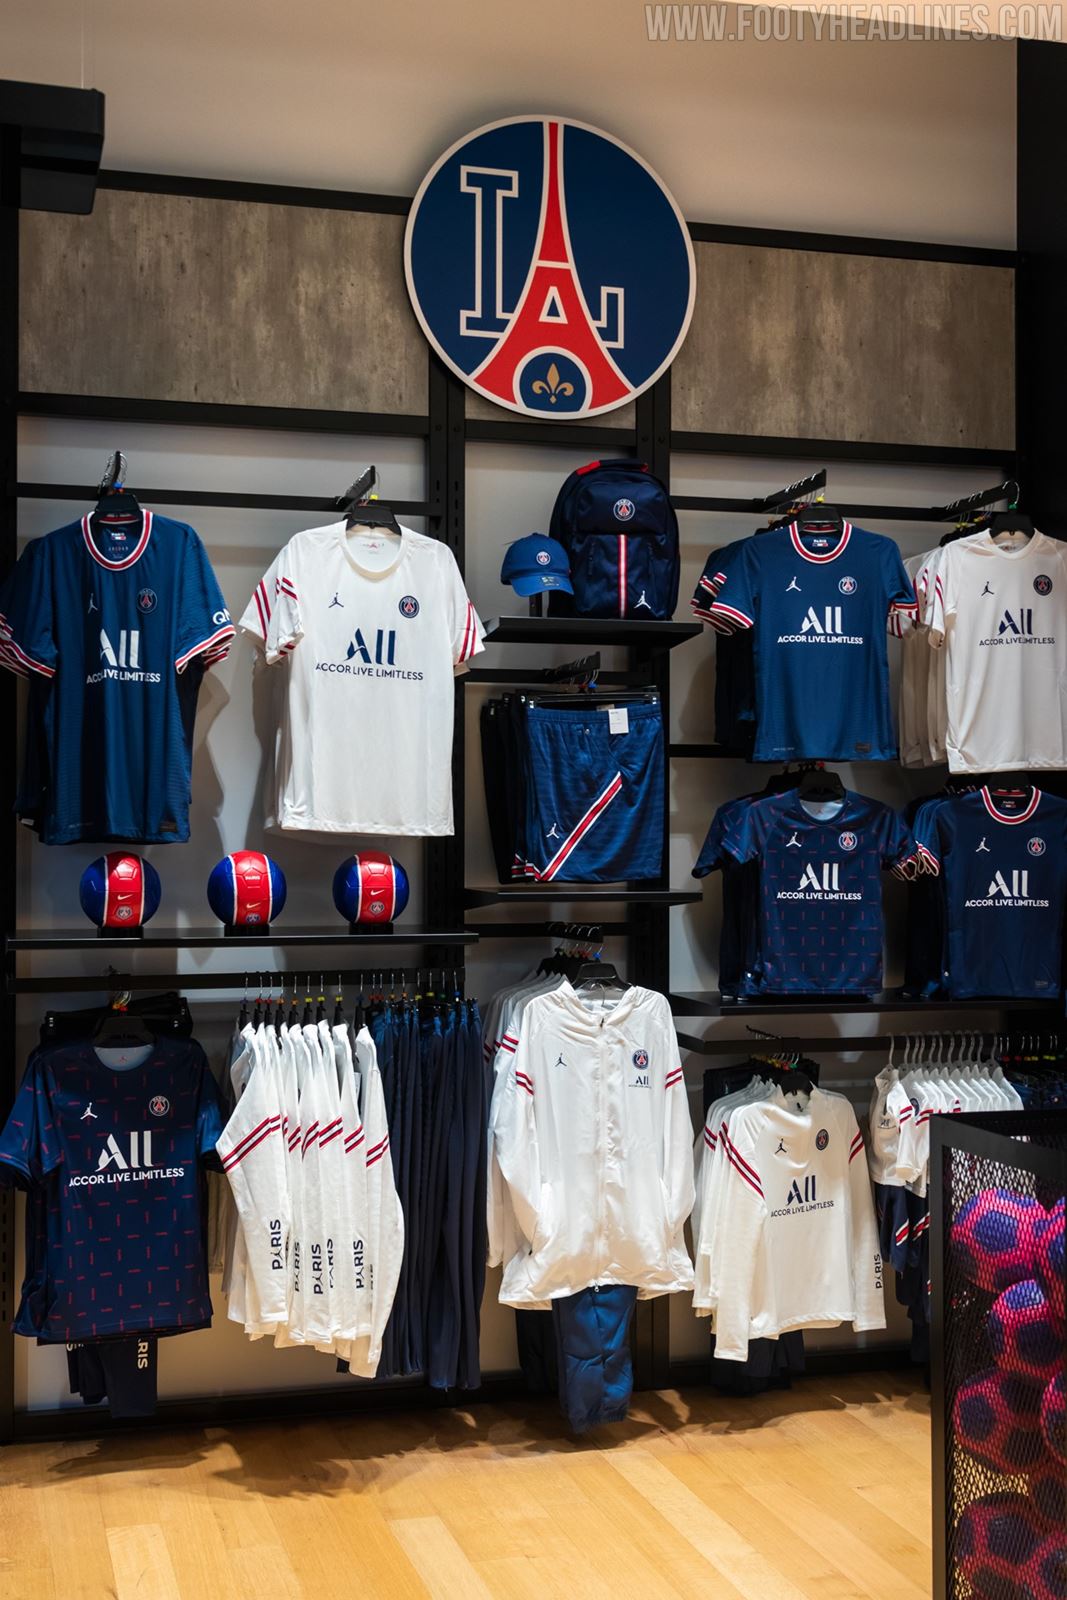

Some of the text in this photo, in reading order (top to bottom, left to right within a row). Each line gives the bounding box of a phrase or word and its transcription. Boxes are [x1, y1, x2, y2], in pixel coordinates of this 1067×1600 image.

[777, 635, 807, 643] ACCOR
[827, 636, 863, 645] LIMITLESS
[120, 671, 160, 683] LIMITESS
[315, 662, 423, 680] ACCOR LIVE LIMITLESS
[777, 892, 862, 900] ACCOR LIVE LIMITLESS
[965, 899, 994, 908] ACCOR
[1014, 900, 1049, 908] LIMITLESS
[69, 1168, 185, 1187] ACCOR LIVE LIMITLESS
[770, 1200, 834, 1217] ACCOR LIVE LIMITLESS
[270, 1219, 283, 1270] PARIS
[311, 1244, 323, 1294] PARIS
[874, 1253, 882, 1288] PARIS
